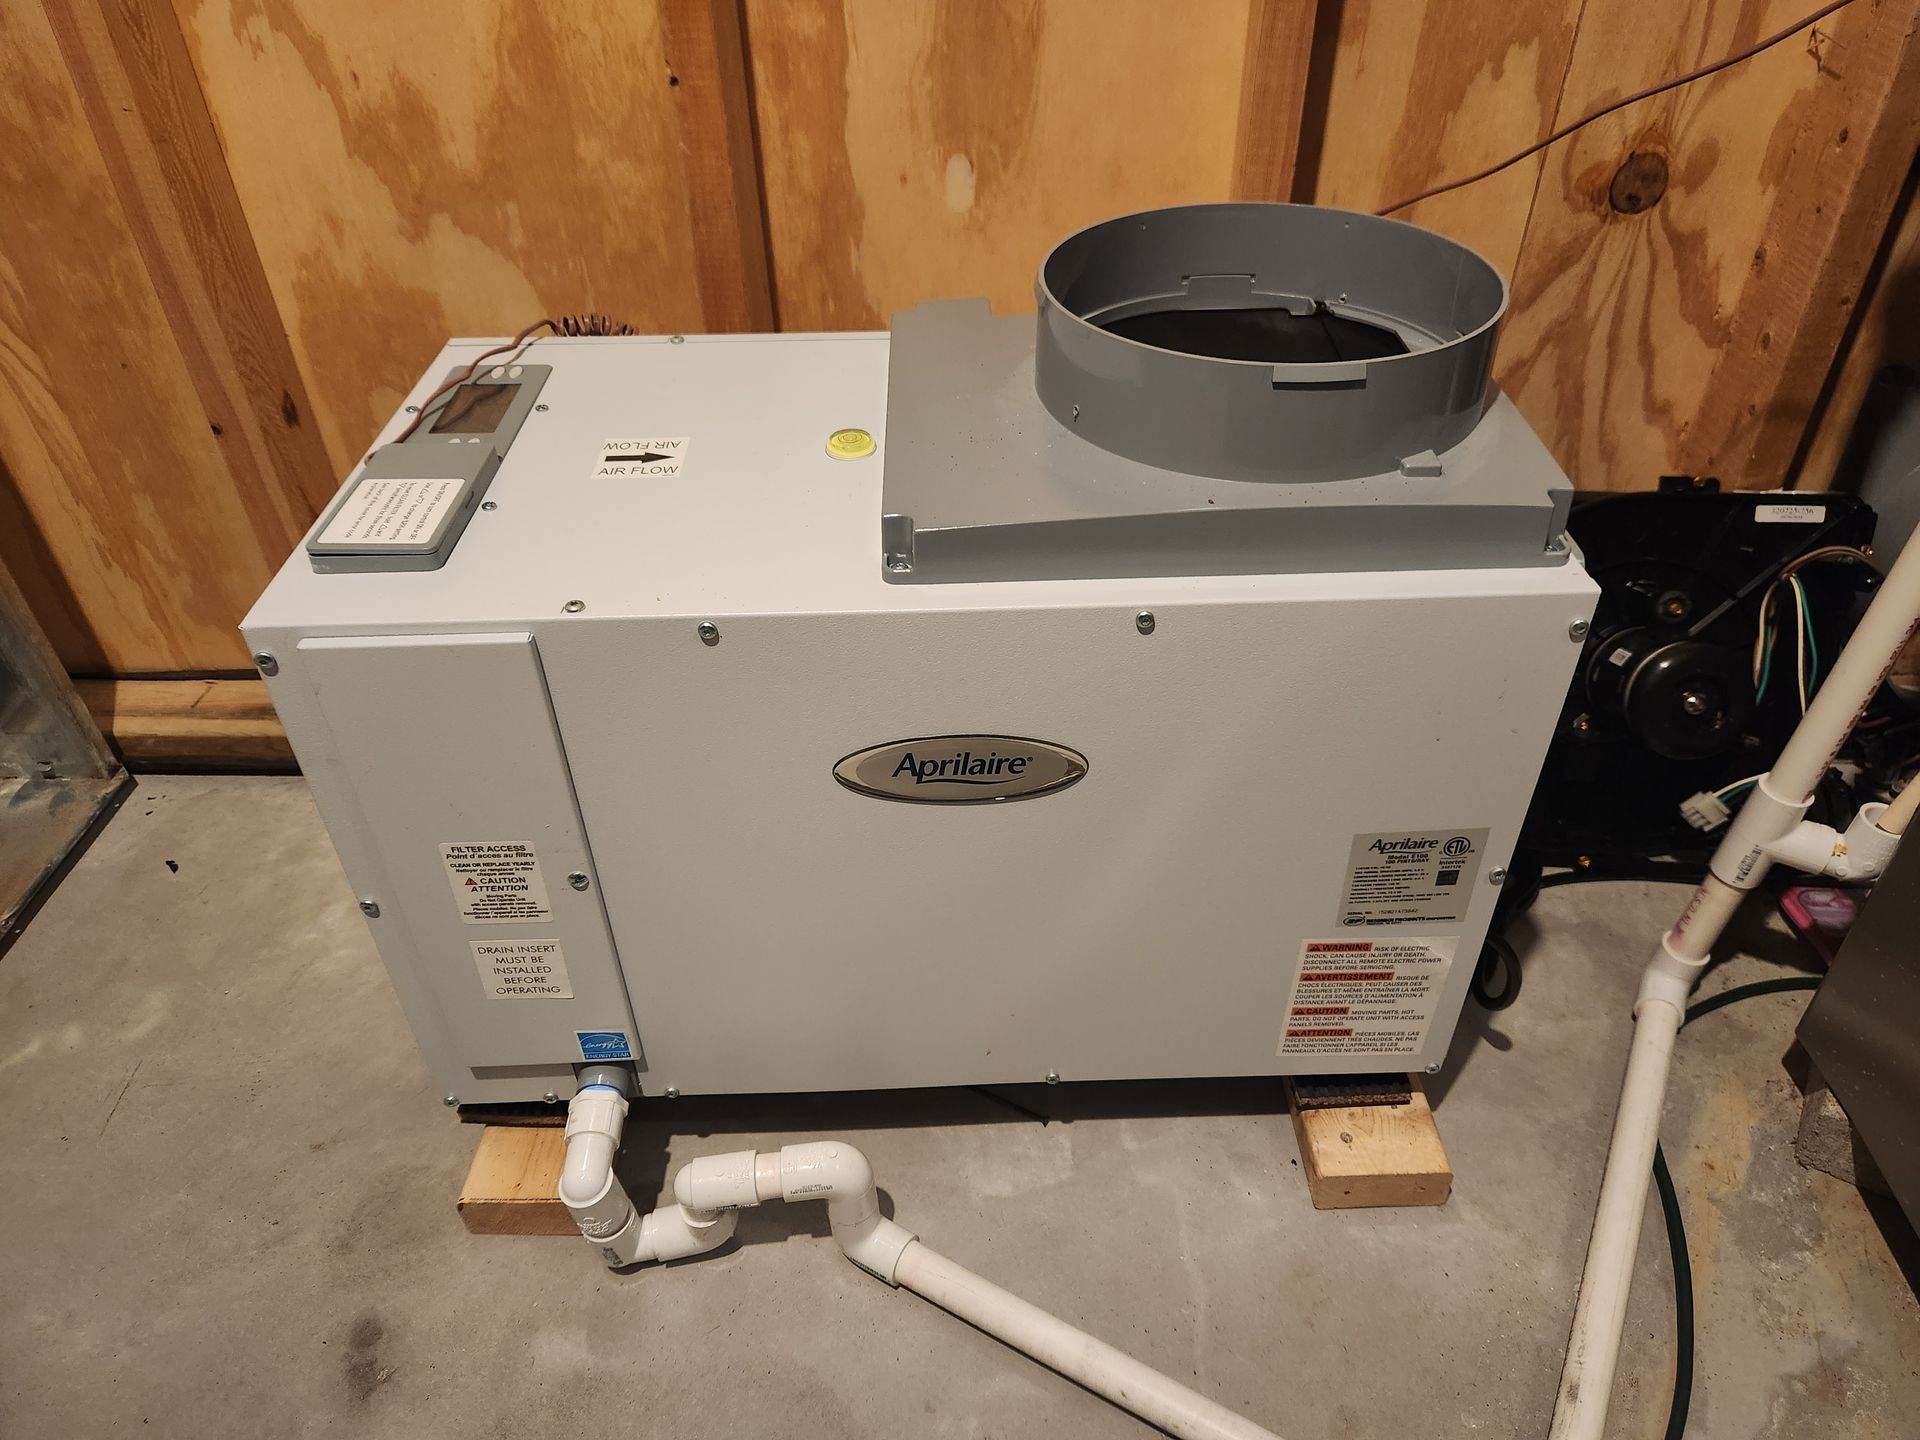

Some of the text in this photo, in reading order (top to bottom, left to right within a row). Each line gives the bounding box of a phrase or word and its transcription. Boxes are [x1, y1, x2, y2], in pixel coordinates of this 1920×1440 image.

[603, 441, 681, 450] AIR FLOW
[598, 466, 678, 475] AIR FLOW
[1368, 838, 1439, 854] Aprilaire
[478, 945, 555, 954] DRAIN INSERT
[1322, 944, 1369, 952] WARNING
[496, 956, 527, 964] MUST
[493, 966, 551, 975] INSTALLED
[504, 976, 547, 984] BEFORE
[1315, 972, 1393, 980] AVERTISSEMENT
[496, 986, 561, 994] OPERATING
